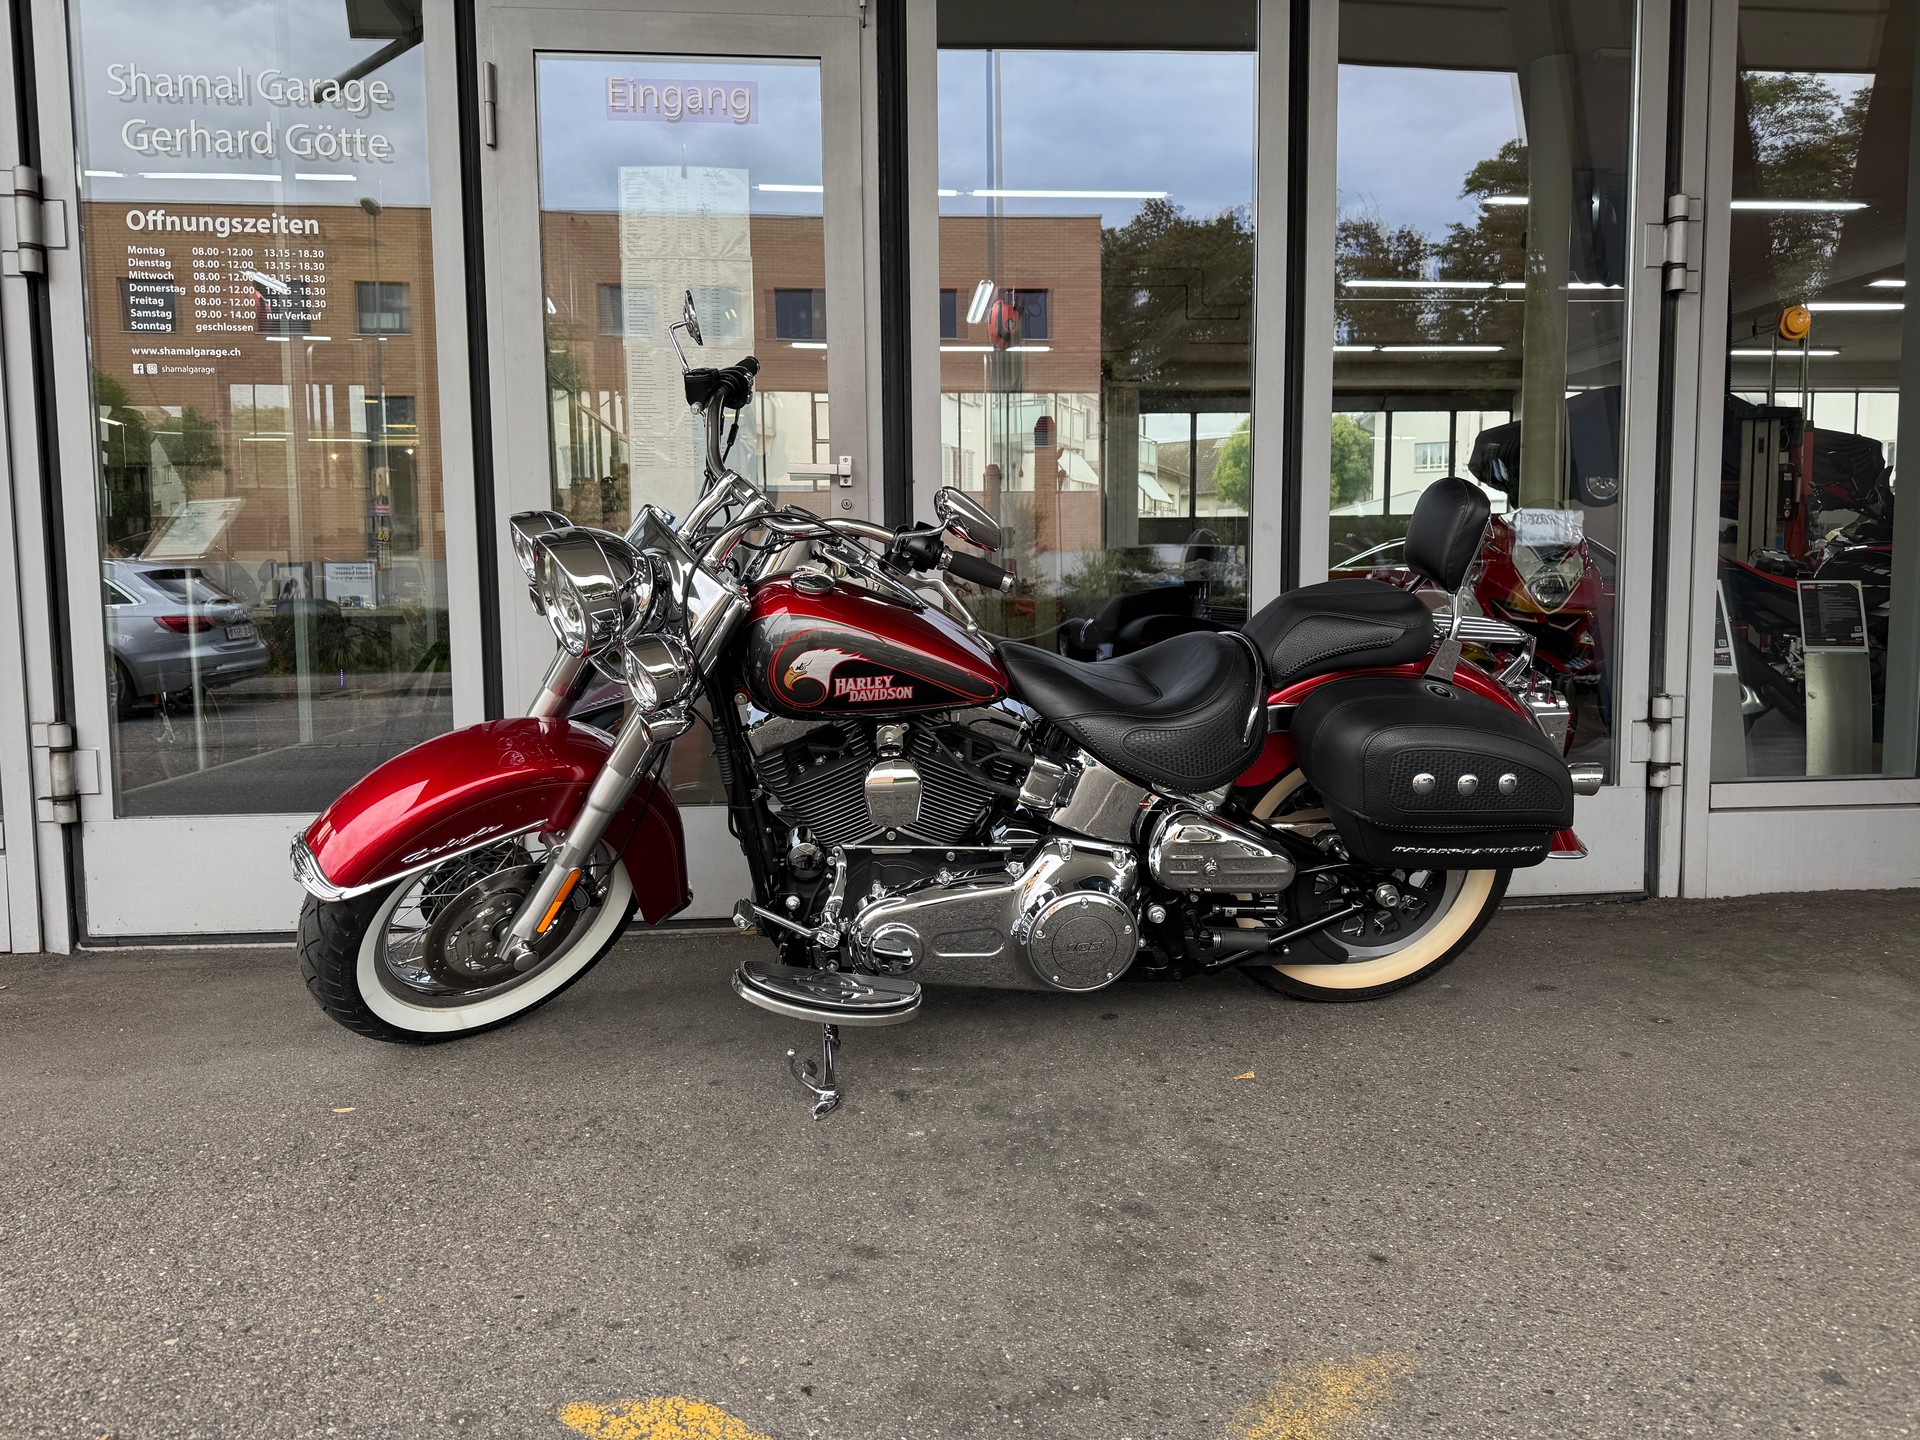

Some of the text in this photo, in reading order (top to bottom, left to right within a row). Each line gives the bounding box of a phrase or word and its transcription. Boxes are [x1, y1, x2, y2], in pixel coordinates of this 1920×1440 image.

[107, 63, 391, 113] Shamal Garage
[608, 76, 751, 119] Eingang
[121, 118, 390, 158] Gerhard Götte
[127, 246, 166, 256] Montag
[193, 248, 219, 256] 08.00
[227, 249, 254, 257] 12.00
[264, 249, 290, 257] 13.15
[298, 250, 325, 258] 18.30
[128, 258, 172, 269] Dienstag
[193, 260, 220, 269] 08.00
[228, 261, 255, 269] 12.00
[129, 271, 175, 280] Mittwoch
[193, 273, 221, 281] 08.00
[299, 275, 326, 283] 18.30
[129, 284, 187, 295] Donnerstag
[194, 285, 221, 294] 08.00
[229, 286, 256, 294] 12.00
[130, 296, 165, 307] Freitag
[195, 298, 222, 306] 08.00
[230, 298, 257, 307] 12.00
[267, 299, 293, 307] 13.15
[301, 300, 327, 308] 18.30
[130, 309, 173, 319] Samstag
[195, 311, 222, 319] 09.00
[230, 311, 257, 319] 14.00
[285, 312, 322, 320] Verkauf
[131, 321, 254, 333] Sonntag geschlossen
[132, 347, 242, 357] www.shamalgarage.ch
[161, 365, 216, 375] shamalgarage
[834, 675, 894, 697] HARLEY
[848, 686, 914, 702] DAVIDSON
